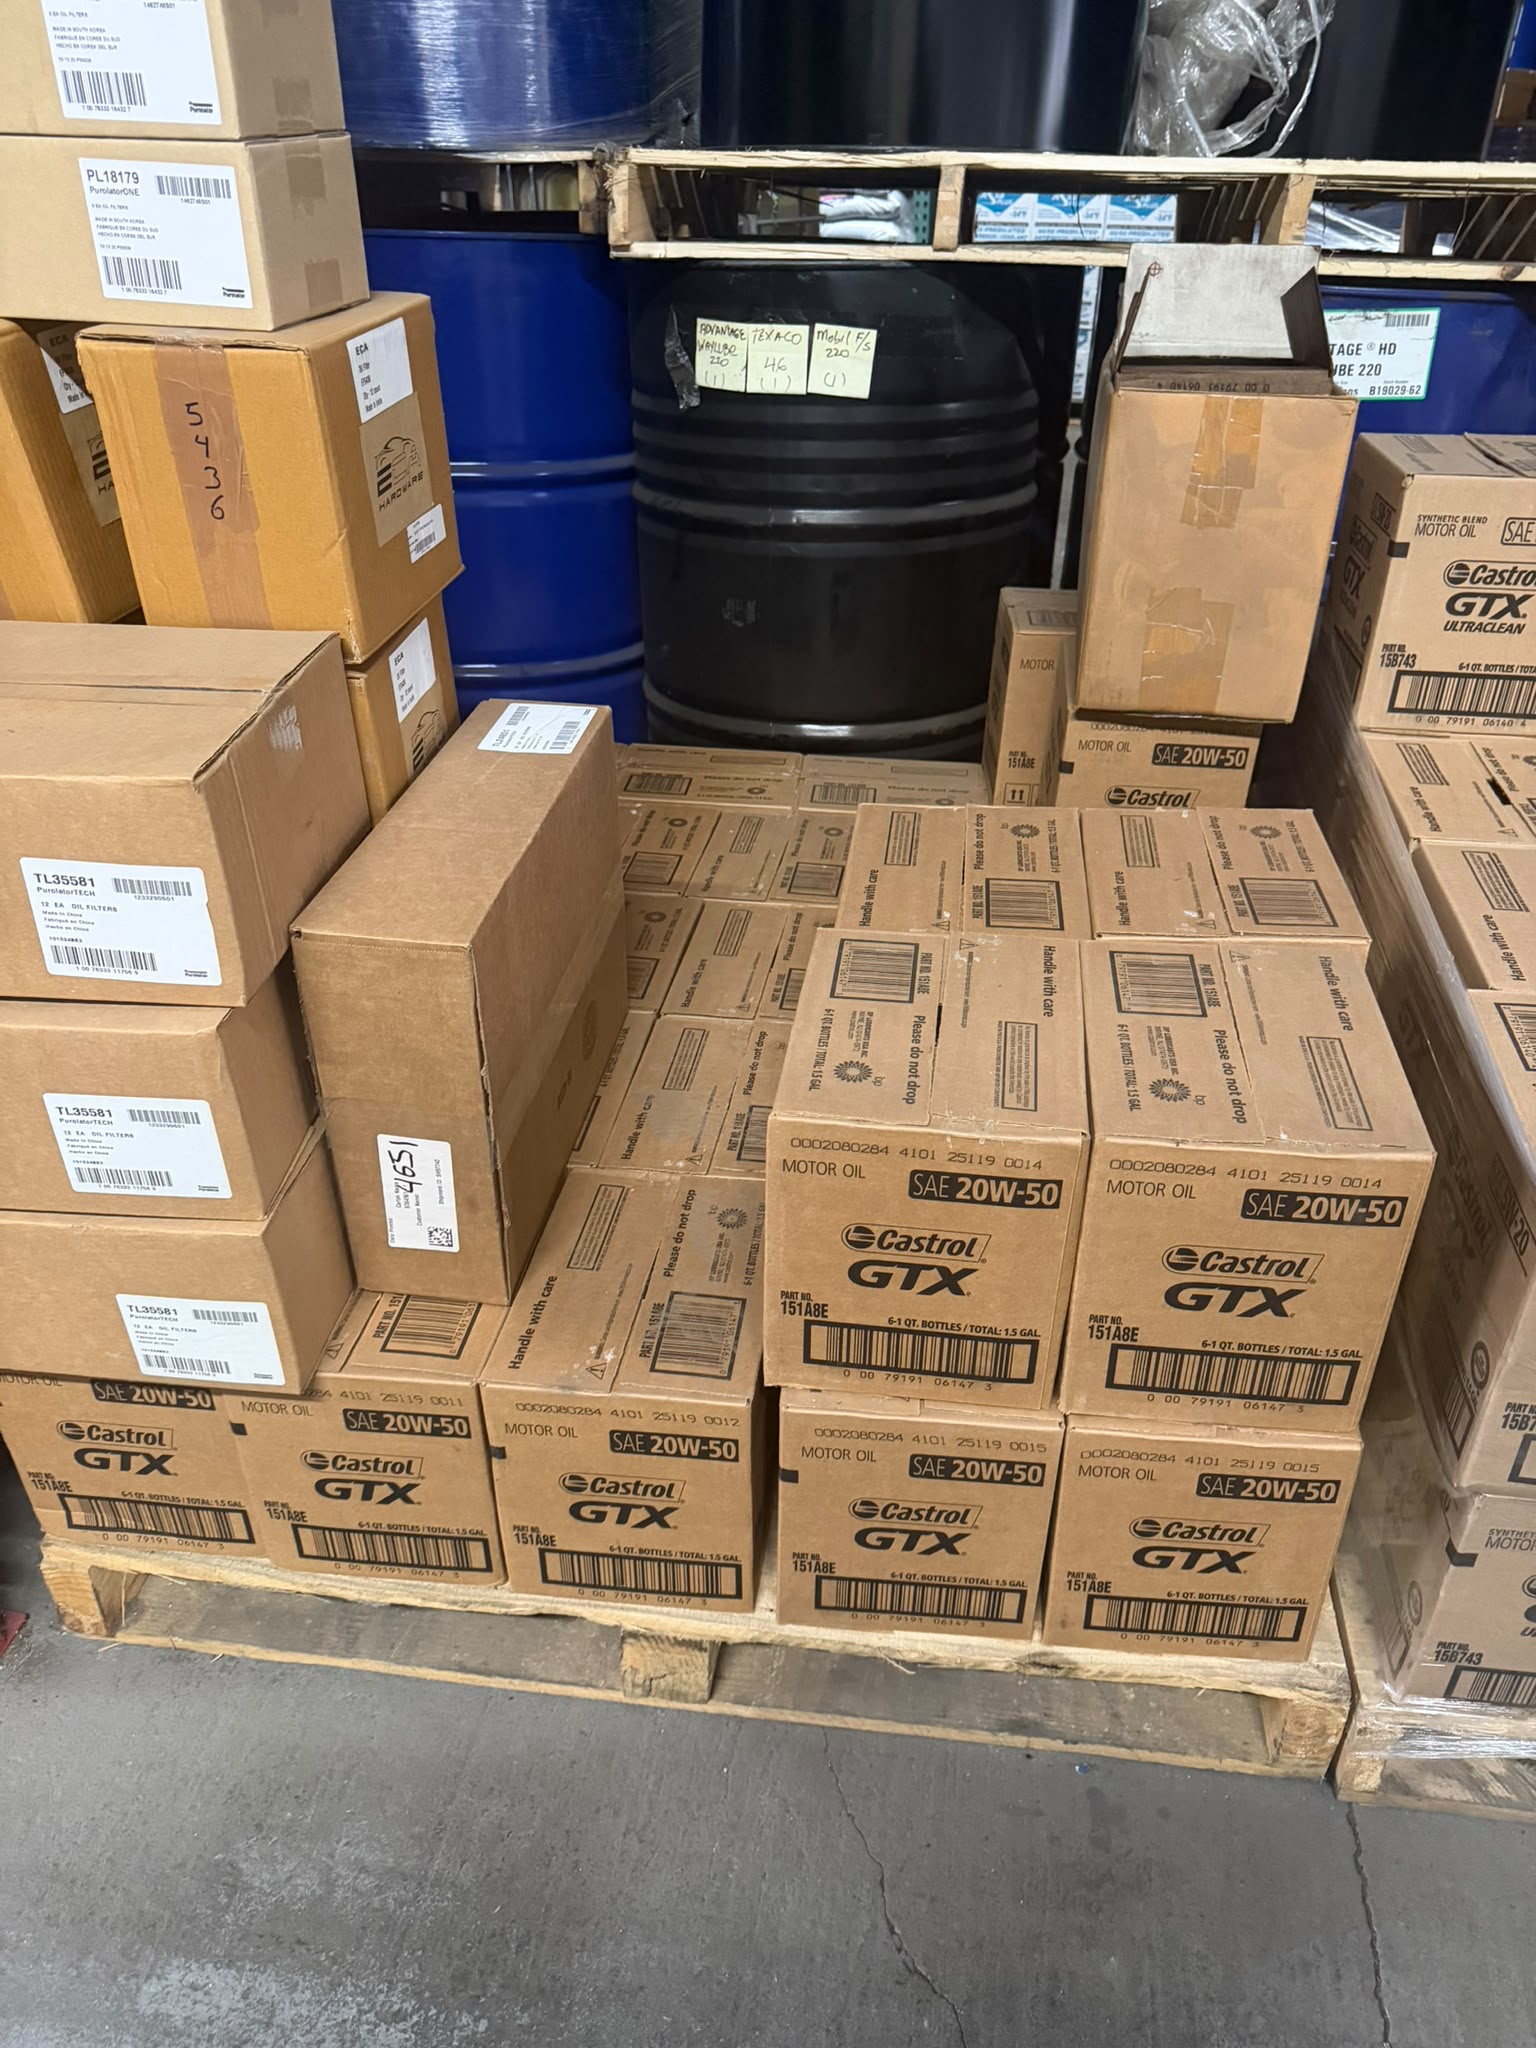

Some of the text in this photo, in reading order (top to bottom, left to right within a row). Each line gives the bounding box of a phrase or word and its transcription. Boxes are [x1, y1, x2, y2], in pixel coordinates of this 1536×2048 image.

[87, 169, 139, 184] PL18179
[90, 186, 139, 196] PurolatorONE
[753, 328, 802, 345] TEXACO
[356, 343, 368, 356] ECA
[826, 348, 849, 358] 220
[1379, 343, 1396, 355] HD
[764, 357, 787, 371] 46
[1359, 364, 1381, 376] 220
[1369, 385, 1421, 395] B19029-62
[379, 472, 423, 512] HARDWARE
[1417, 515, 1488, 524] SYNTHETIC BLEND
[1415, 523, 1477, 538] MOTOR OIL
[1505, 520, 1535, 543] SAE
[1445, 593, 1534, 619] GTX
[1444, 621, 1526, 634] ULTRACLEAN
[1382, 644, 1396, 652] PART
[1020, 659, 1055, 671] MOTOR
[1380, 654, 1416, 668] 15B743
[1416, 715, 1421, 723] 0
[1428, 716, 1440, 725] 00
[1446, 717, 1475, 726] 79191
[1078, 739, 1131, 752] MOTOR OIL
[1008, 757, 1035, 769] 151A8E
[1155, 746, 1246, 768] SAE 20W-50
[1126, 789, 1193, 807] Castrol
[34, 873, 95, 888] TL35581
[36, 886, 95, 897] PurolatorTECH
[87, 904, 117, 913] FILTERS
[1042, 944, 1056, 1018] Handle with care
[902, 1014, 926, 1106] Please do not drop
[56, 1106, 112, 1117] TL35581
[790, 1138, 1042, 1170] 0002080284 4101 25119 0014
[388, 1141, 423, 1193] 4651
[782, 1159, 866, 1179] MOTOR OIL
[1110, 1159, 1382, 1189] 0002080284 4101 25119 0014
[913, 1173, 1059, 1206] SAE 20W-50
[1106, 1179, 1196, 1199] MOTOR OIL
[1246, 1192, 1403, 1224] SAE 20W-50
[663, 1189, 696, 1277] Please do not drop
[877, 1229, 978, 1257] Castrol
[1200, 1249, 1310, 1278] Castrol
[848, 1260, 979, 1296] GTX
[781, 1290, 813, 1301] PART NO.
[1164, 1282, 1307, 1318] GTX
[781, 1301, 828, 1318] 151A8E
[508, 1275, 558, 1369] Handle with care
[888, 1316, 902, 1326] 6-1
[904, 1318, 919, 1328] QT.
[921, 1319, 962, 1332] BOTTLES
[1004, 1327, 1018, 1336] 1.5
[1019, 1328, 1040, 1337] GAL.
[1089, 1314, 1123, 1325] PART NO.
[1088, 1324, 1139, 1342] 151A8E
[95, 1385, 212, 1409] SAE 20W-50
[241, 1402, 312, 1417] MOTOR OIL
[516, 1403, 740, 1427] 0002080284 4101 25119 0012
[347, 1411, 469, 1436] SAE 20W-50
[504, 1423, 578, 1438] MOTOR OIL
[87, 1424, 167, 1447] Castrol
[613, 1432, 737, 1460] SAE 20W-50
[801, 1446, 877, 1462] MOTOR OIL
[74, 1448, 175, 1475] GTX
[332, 1454, 414, 1474] Castrol
[912, 1456, 1043, 1484] SAE 20W-50
[1080, 1449, 1319, 1473] 0002080284 4101 25119 0015
[1078, 1464, 1157, 1481] MOTOR OIL
[31, 1478, 73, 1493] 151A8E
[314, 1478, 420, 1505] GTX
[591, 1477, 675, 1499] Castrol
[1201, 1476, 1336, 1501] SAE 20W-50
[266, 1507, 308, 1523] 151A8E
[569, 1501, 679, 1529] GTX
[880, 1502, 972, 1525] Castrol
[514, 1532, 557, 1547] 151A8E
[854, 1527, 972, 1556] GTX
[1162, 1521, 1258, 1544] Castrol
[792, 1561, 836, 1574] 151A8E
[1132, 1546, 1256, 1574] GTX
[1066, 1579, 1112, 1594] 151A8E
[1437, 1641, 1456, 1650] PART
[1434, 1650, 1483, 1666] 15B743
